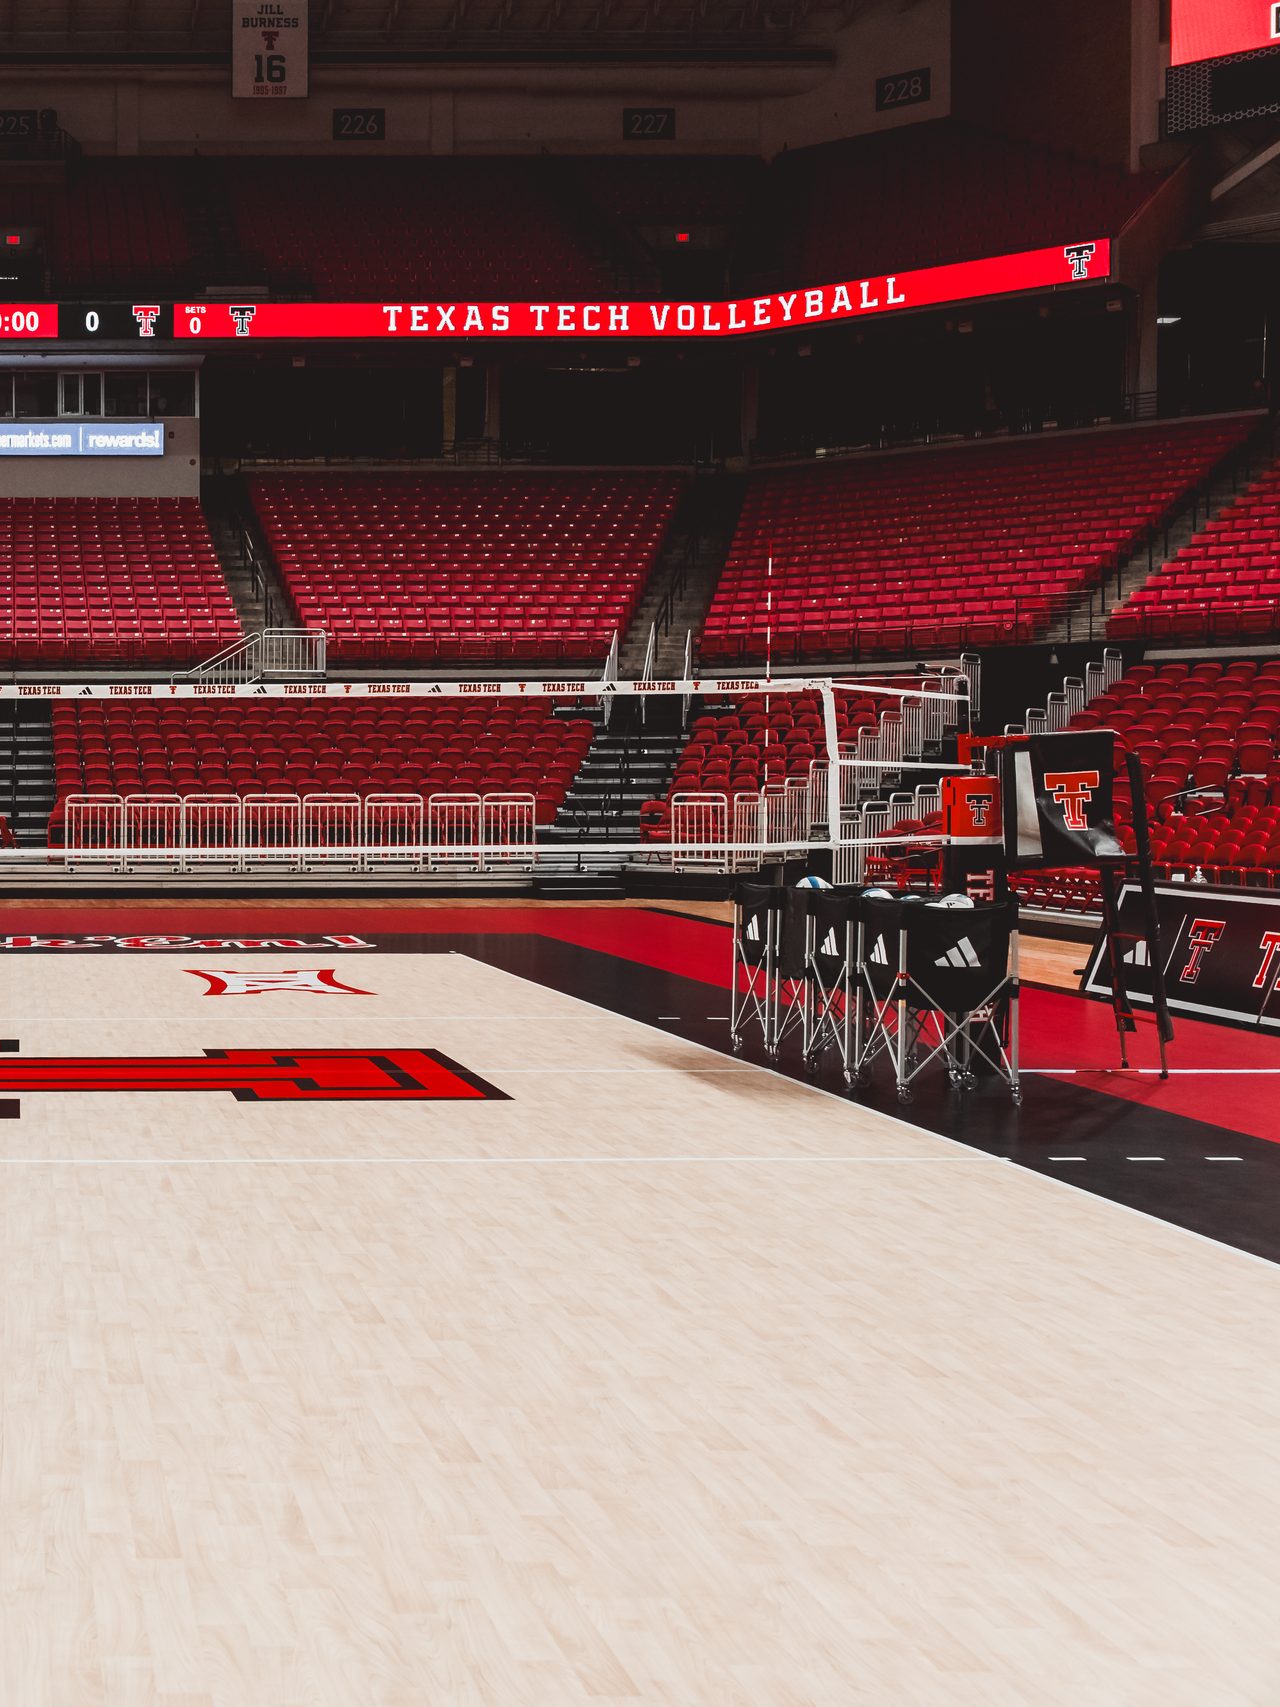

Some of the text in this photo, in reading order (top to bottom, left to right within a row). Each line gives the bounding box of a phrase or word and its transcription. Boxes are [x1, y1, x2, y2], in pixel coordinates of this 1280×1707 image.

[257, 4, 284, 15] JILL
[242, 17, 299, 28] BURNESS
[254, 54, 286, 83] 16
[883, 76, 924, 103] 228
[340, 114, 378, 135] 226
[631, 113, 668, 135] 227
[383, 276, 907, 332] TEXAS TECH VOLLEYBALL
[185, 306, 207, 314] SETS
[85, 311, 99, 332] 0
[189, 317, 202, 334] 0
[88, 430, 160, 449] rewards!
[110, 685, 152, 696] TEXAS TECH
[193, 685, 235, 695] TEXAS TECH
[284, 684, 326, 694] TEXAS TECH
[368, 684, 410, 694] TEXAS TECH
[459, 683, 501, 693] TEXAS TECH
[543, 682, 585, 692] TEXAS TECH
[633, 681, 675, 691] TEXAS TECH
[717, 680, 740, 690] TEXAS
[18, 686, 60, 696] TEXAS TECH
